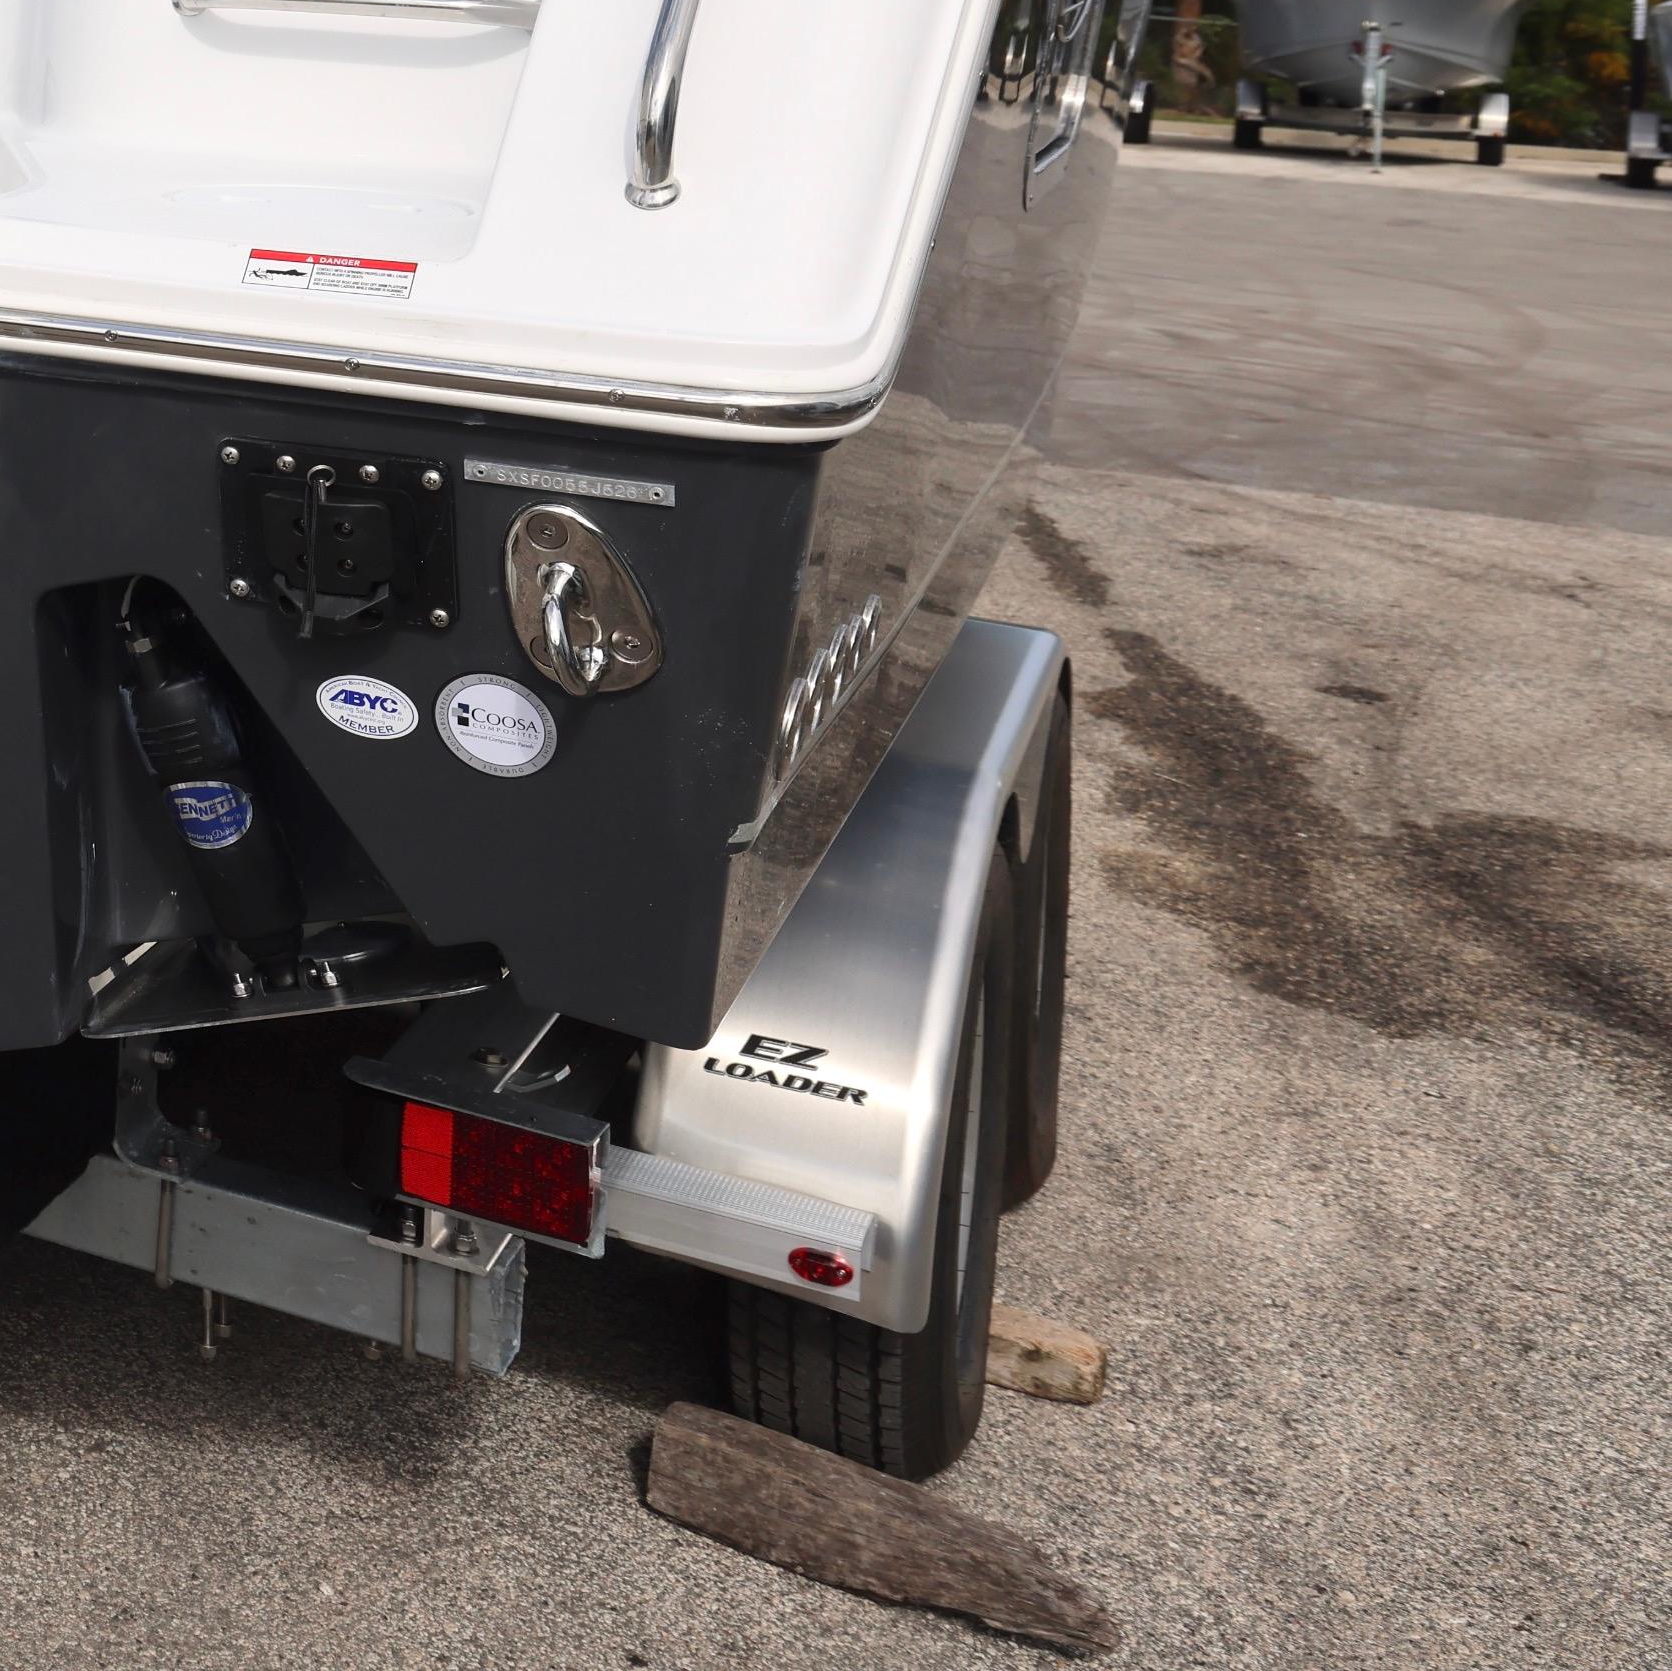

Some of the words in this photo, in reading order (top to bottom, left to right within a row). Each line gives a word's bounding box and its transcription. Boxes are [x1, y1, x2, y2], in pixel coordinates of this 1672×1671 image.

[319, 258, 361, 266] DANGER
[329, 689, 398, 714] ABYC
[339, 716, 395, 734] MEMBER
[471, 708, 538, 733] COOSA
[738, 1034, 829, 1071] EZ
[703, 1057, 868, 1106] LOADER
